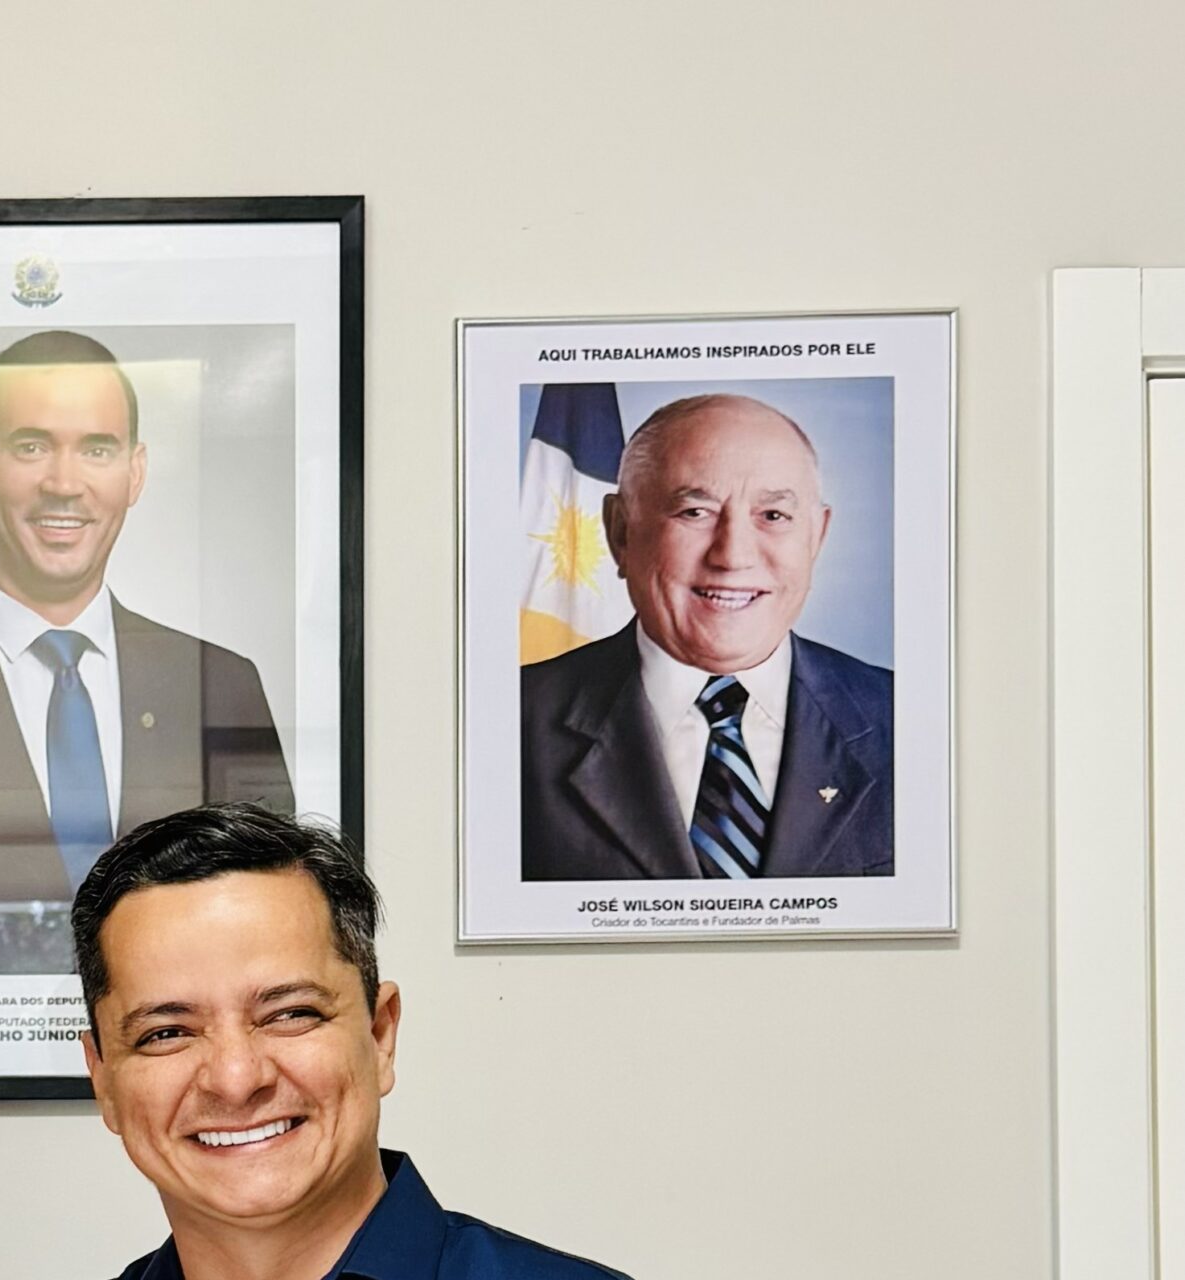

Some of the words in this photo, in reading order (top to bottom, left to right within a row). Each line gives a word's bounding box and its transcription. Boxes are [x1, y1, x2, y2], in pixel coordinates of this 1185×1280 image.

[538, 349, 576, 362] AQUI
[581, 347, 701, 361] TRABALHAMOS
[706, 344, 803, 359] INSPIRADOS
[808, 343, 841, 356] POR
[846, 343, 876, 355] ELE
[577, 897, 618, 913] JOSÉ
[623, 899, 685, 912] WILSON
[690, 898, 765, 911] SIQUEIRA
[769, 897, 839, 910] CAMPOS
[591, 916, 630, 928] Criador
[633, 916, 648, 927] do
[651, 915, 700, 927] Tocantins
[702, 918, 709, 927] e
[712, 915, 763, 926] Fundador
[764, 915, 779, 926] de
[782, 914, 821, 925] Palmas
[20, 997, 44, 1006] DOS
[47, 997, 86, 1005] DEPUT
